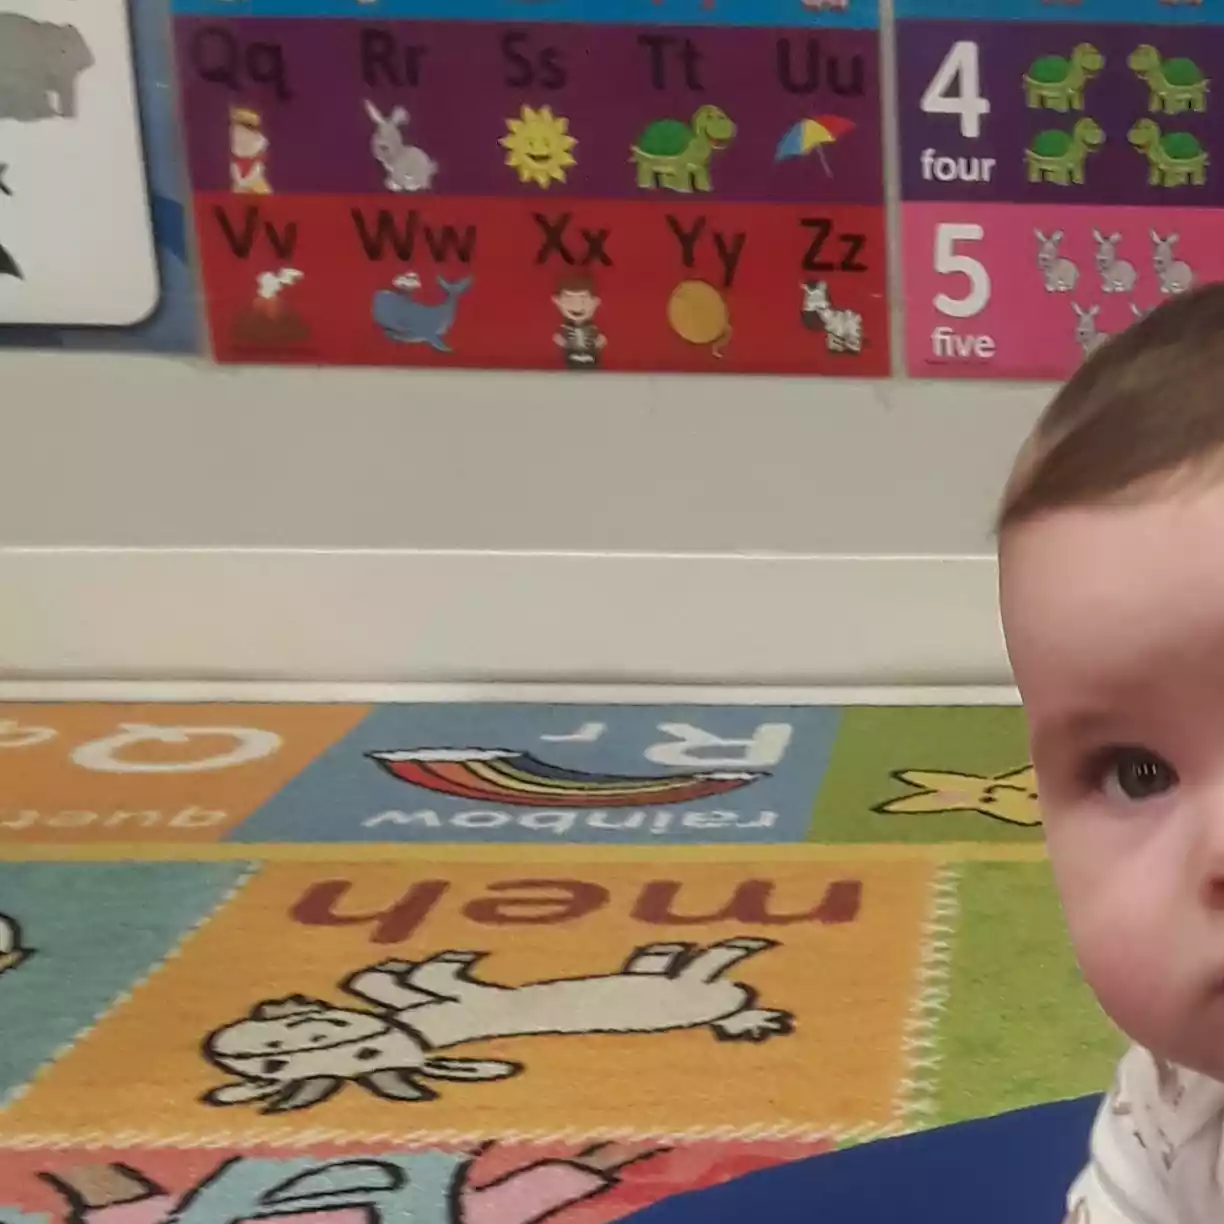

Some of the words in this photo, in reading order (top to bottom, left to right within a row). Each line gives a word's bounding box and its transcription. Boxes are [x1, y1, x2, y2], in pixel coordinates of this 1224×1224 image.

[360, 28, 429, 88] Rr
[502, 31, 567, 91] Ss
[637, 33, 706, 91] Tt
[776, 37, 866, 97] Uu
[920, 40, 990, 138] 4
[920, 147, 996, 183] four
[214, 205, 298, 260] Vv
[350, 207, 478, 263] Ww
[533, 212, 614, 268] Xx
[665, 214, 747, 287] Yy
[799, 218, 868, 273] Zz
[932, 223, 990, 317] 5
[931, 327, 996, 358] five
[70, 723, 283, 774] Q
[645, 721, 794, 768] R
[361, 806, 780, 835] rainbow
[288, 877, 863, 944] meh
